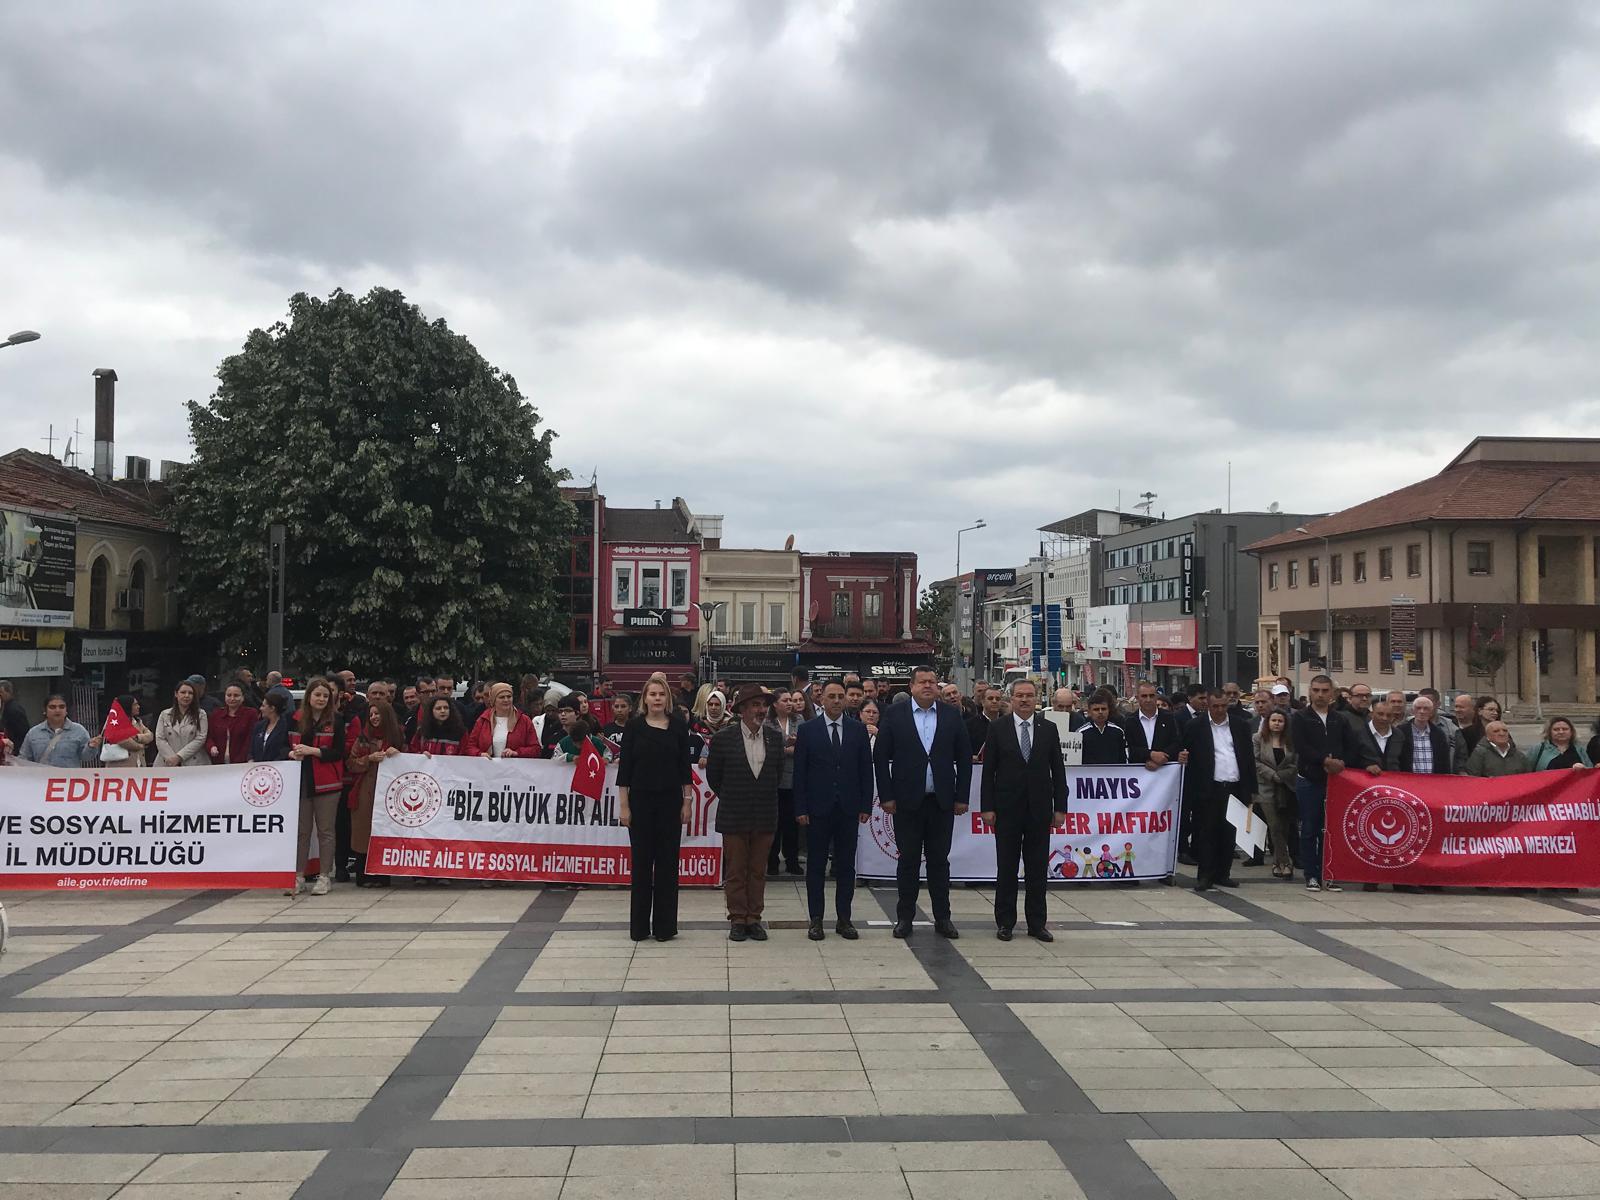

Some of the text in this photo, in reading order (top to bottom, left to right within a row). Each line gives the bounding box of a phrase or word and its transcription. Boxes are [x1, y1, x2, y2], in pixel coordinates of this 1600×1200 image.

[986, 573, 1014, 582] arçelik
[630, 617, 659, 626] PUMA
[45, 773, 170, 802] EDİRNE
[1076, 777, 1141, 799] MAYIS
[488, 785, 552, 824] BÜYÜK
[590, 788, 628, 826] AİL
[1444, 801, 1510, 822] UZUNKÖPRÜ
[1511, 804, 1547, 822] BAKIM
[30, 815, 132, 834] SOSYAL
[140, 810, 284, 834] HİZMETLER
[1096, 810, 1172, 834] HAFTASI
[6, 840, 205, 866] İL MÜDÜRLÜĞÜ
[1441, 832, 1577, 859] AİLE DANIŞMA MERKEZİ
[382, 844, 431, 867] EDİRNE
[433, 847, 465, 869] AİLE
[468, 852, 486, 870] VE
[488, 853, 538, 872] SOSYAL
[542, 851, 615, 875] HİZMETLER
[619, 854, 631, 876] İL
[57, 877, 148, 888] aile.gov.tr/edirne
